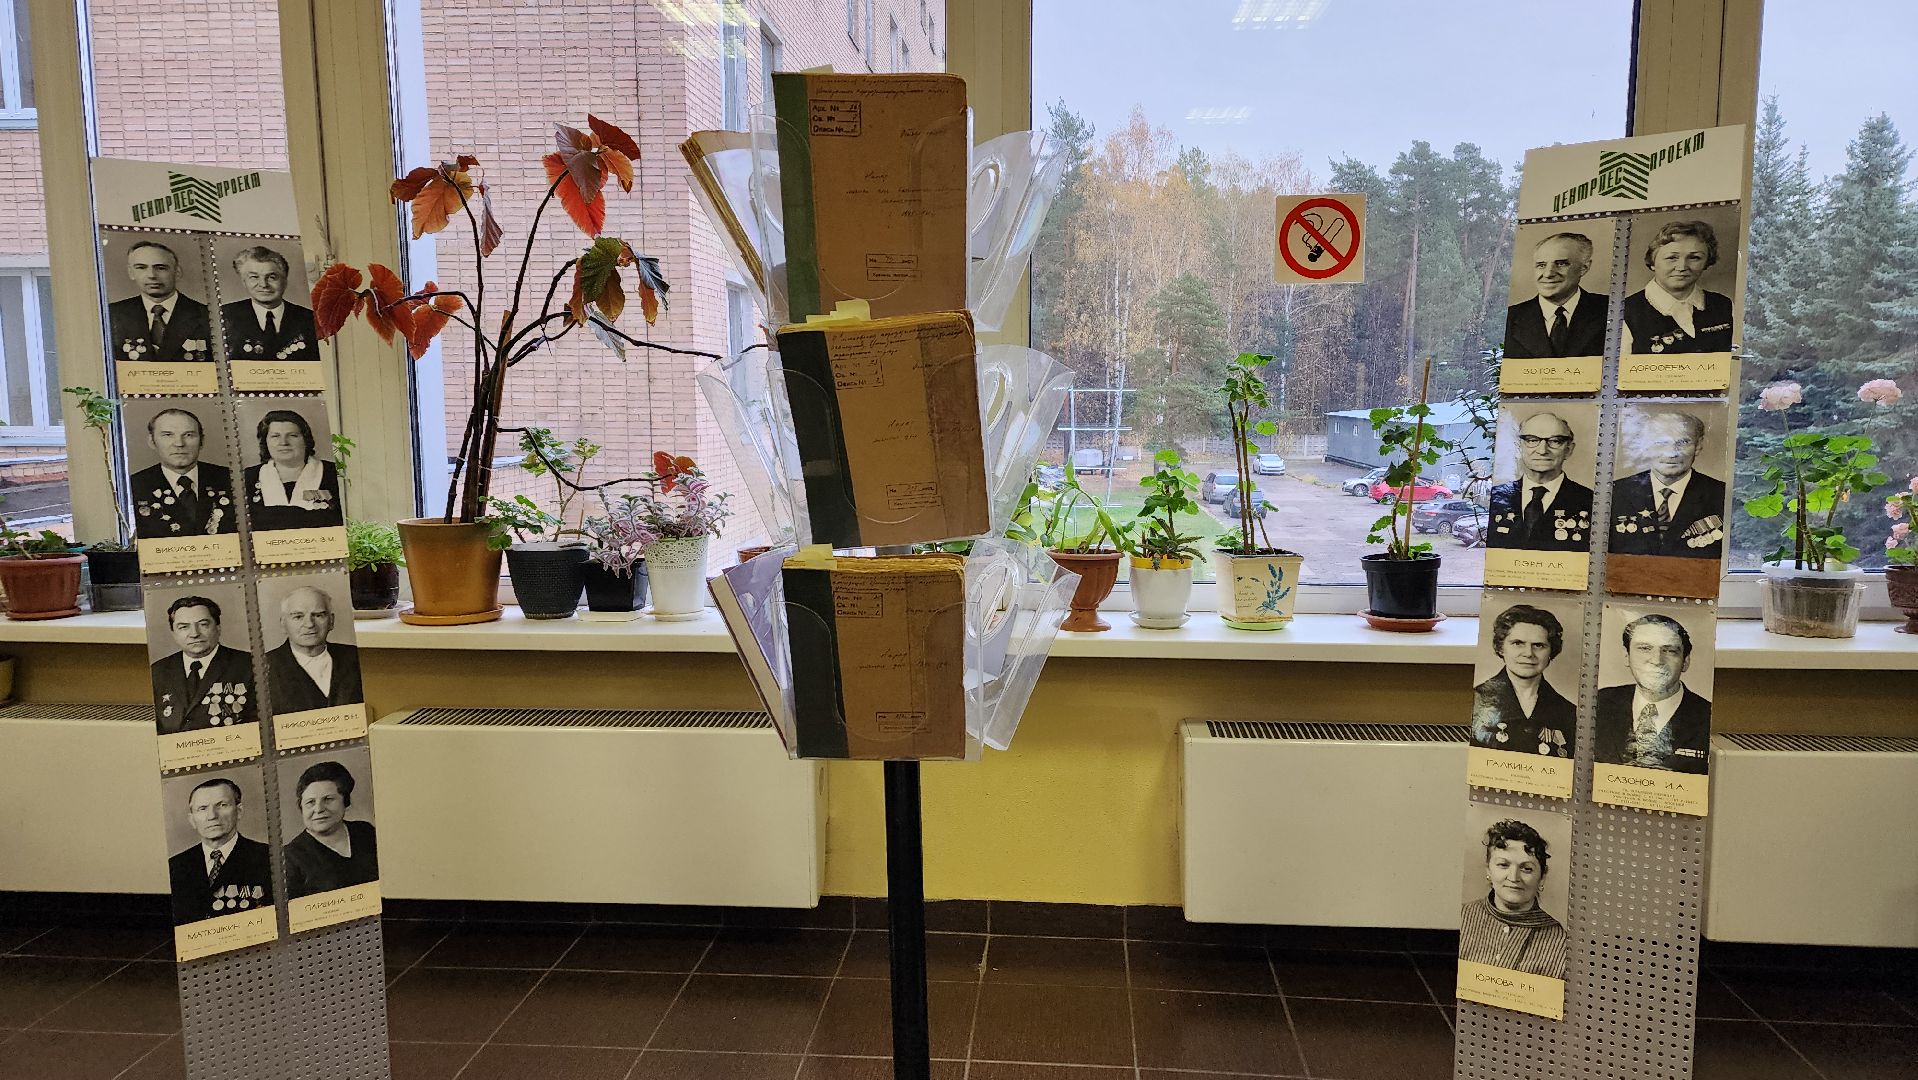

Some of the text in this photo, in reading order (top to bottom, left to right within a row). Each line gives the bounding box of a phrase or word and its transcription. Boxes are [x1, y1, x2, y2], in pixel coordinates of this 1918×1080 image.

[249, 368, 286, 376] ОСИПОВ
[1523, 367, 1557, 376] ЗОТОВ
[155, 543, 198, 554] ВИКУЛОВ
[280, 714, 340, 729] НИКОЛЬСКИЙ
[176, 737, 216, 749] МИНЯЕВ
[1486, 758, 1535, 773] ГАЛКИНА
[1607, 774, 1656, 787] САЗОНОВ
[187, 922, 241, 940] МАТЮШКИН
[1475, 973, 1515, 988] ЮРКОВА
